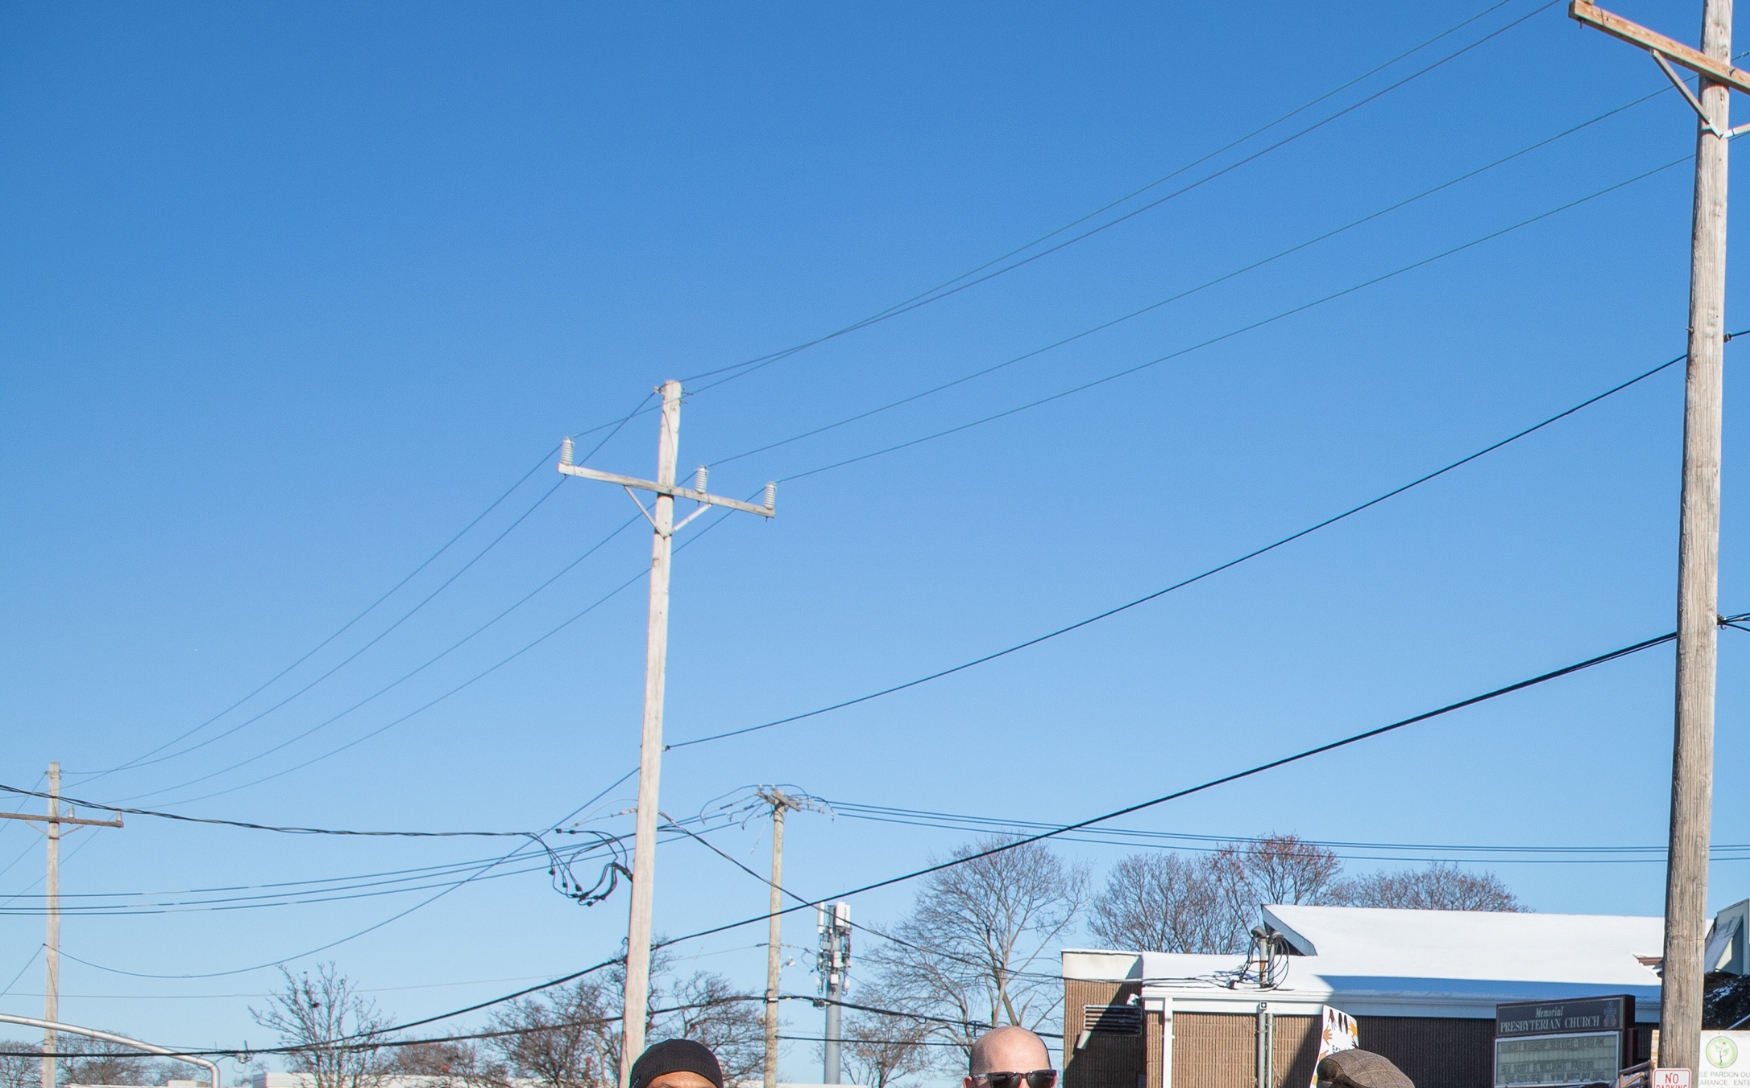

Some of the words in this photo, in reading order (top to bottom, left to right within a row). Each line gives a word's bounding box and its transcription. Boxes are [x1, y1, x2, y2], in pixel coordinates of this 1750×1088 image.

[1535, 1006, 1564, 1018] Memorial
[1500, 1018, 1561, 1033] PRESBYTERIAN
[1565, 1016, 1600, 1028] CHURCH
[1665, 1073, 1679, 1084] NO
